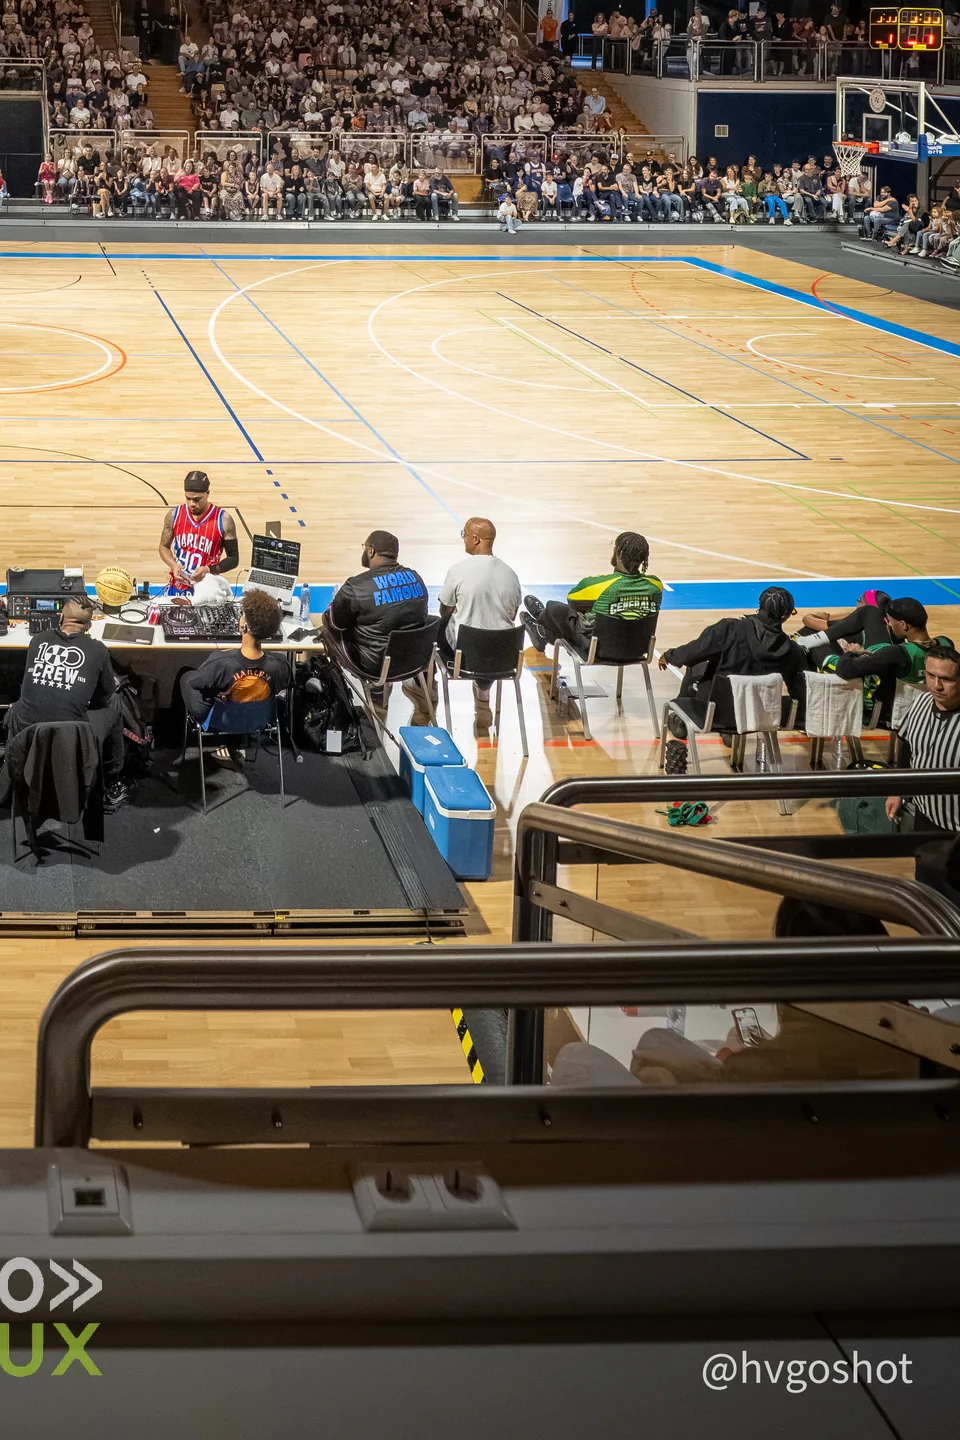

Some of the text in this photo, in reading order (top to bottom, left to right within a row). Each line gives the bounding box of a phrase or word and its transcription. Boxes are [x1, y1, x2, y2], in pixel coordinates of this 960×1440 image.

[373, 571, 417, 590] WORLD
[373, 583, 424, 606] FAMOUS
[610, 601, 657, 615] GENERALS
[32, 664, 79, 685] CREW
[233, 669, 271, 681] HARLEM
